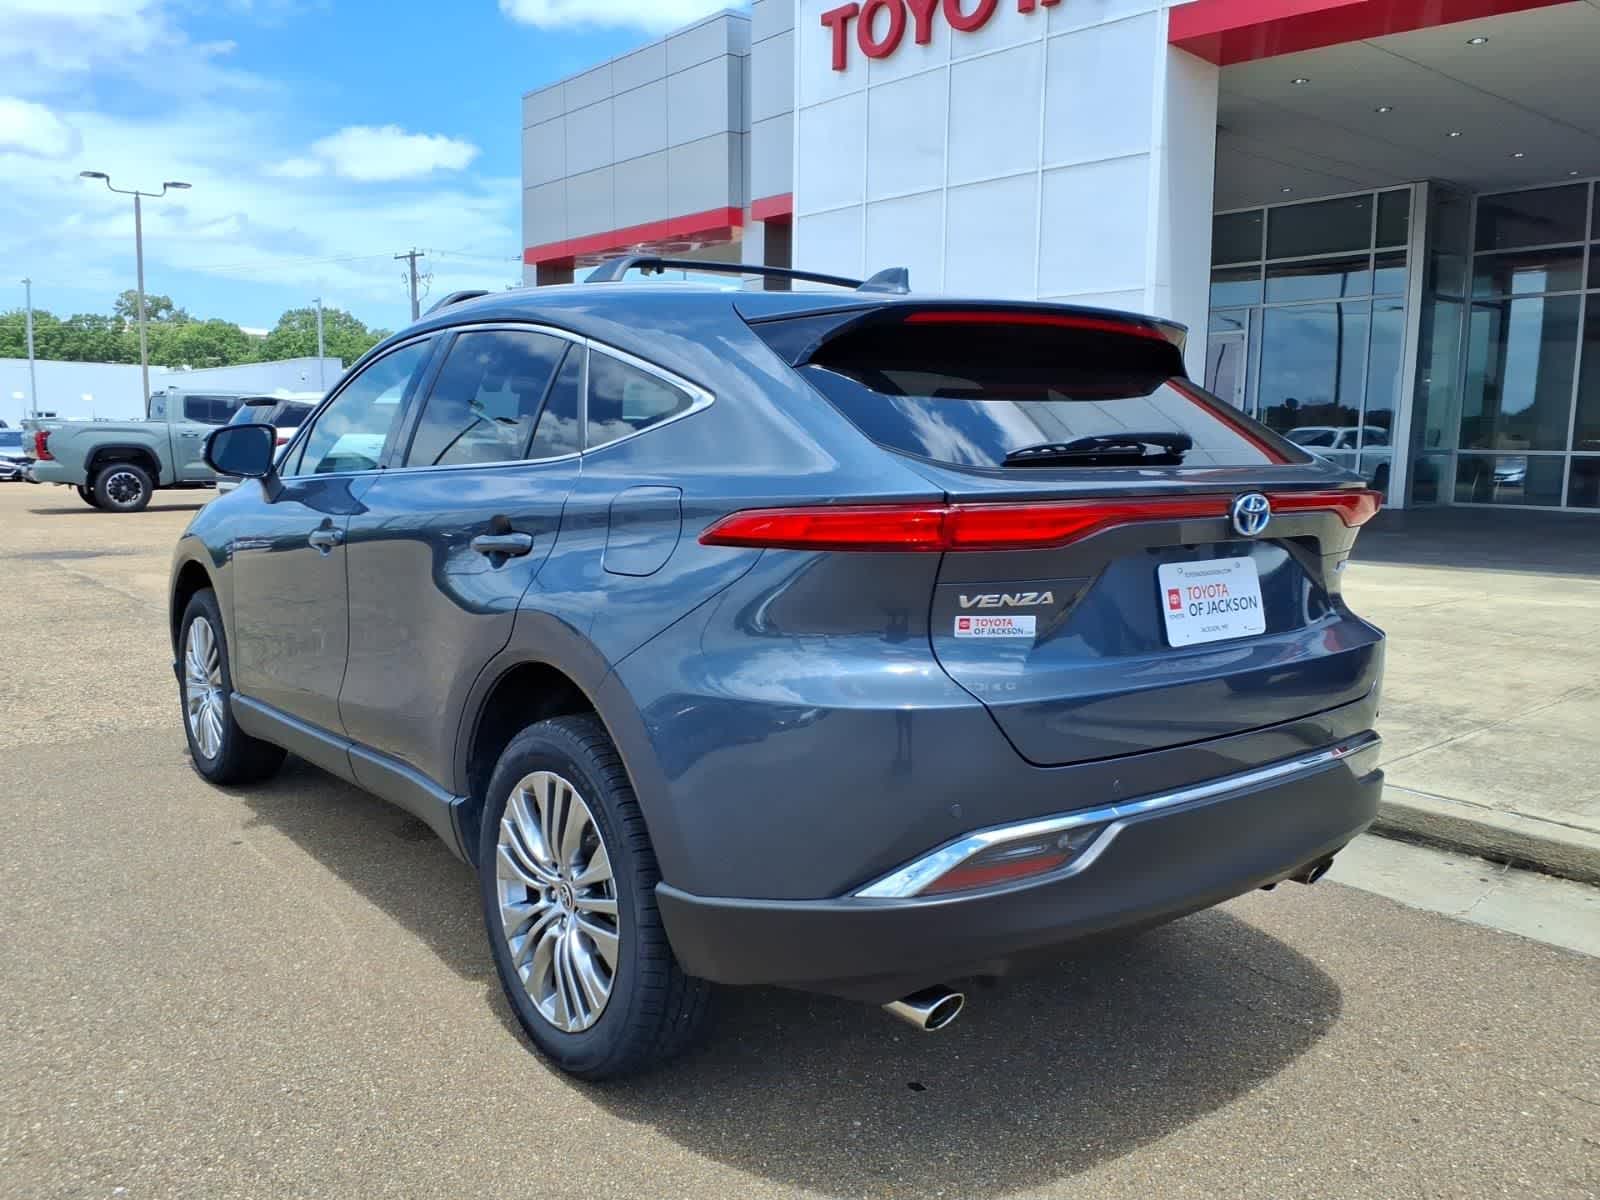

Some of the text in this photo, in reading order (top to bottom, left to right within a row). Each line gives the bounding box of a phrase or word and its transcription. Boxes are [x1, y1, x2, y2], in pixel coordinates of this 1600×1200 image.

[820, 0, 1064, 71] TOY
[959, 591, 1054, 608] VENZA
[1186, 584, 1230, 601] TOYOTA
[1189, 596, 1258, 617] OF JACKSON
[975, 618, 1013, 627] TOYOTA
[987, 627, 1024, 635] JACKSON
